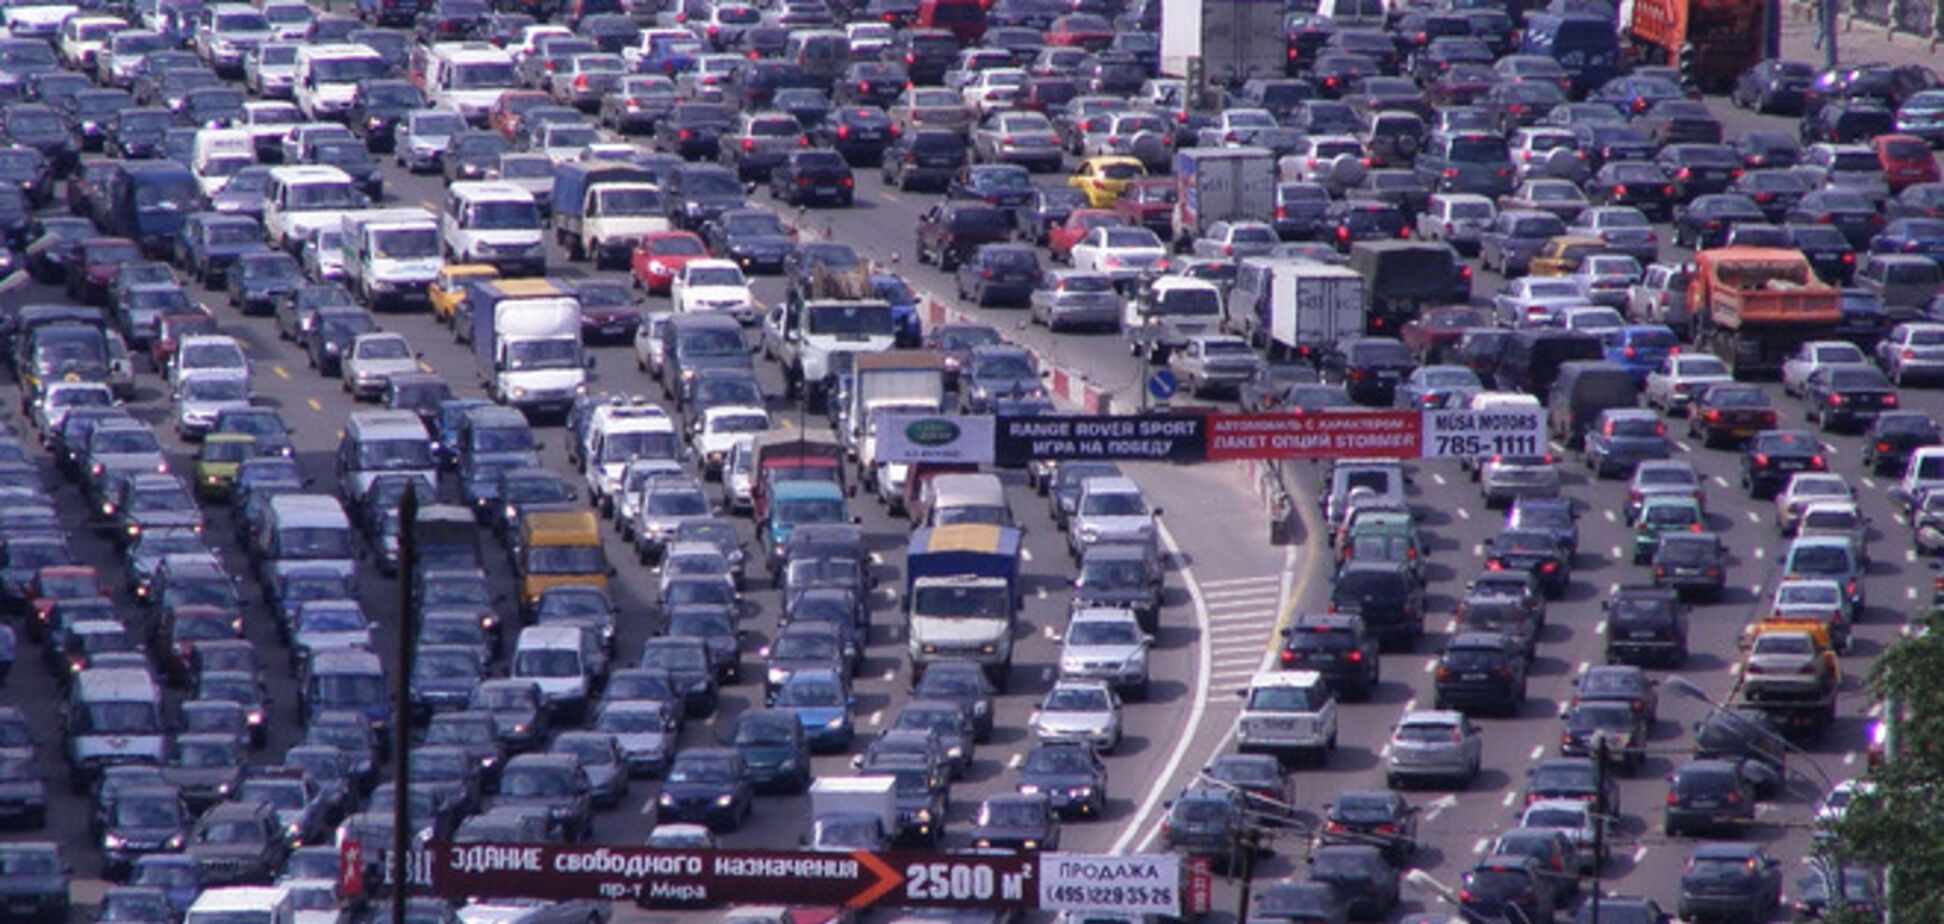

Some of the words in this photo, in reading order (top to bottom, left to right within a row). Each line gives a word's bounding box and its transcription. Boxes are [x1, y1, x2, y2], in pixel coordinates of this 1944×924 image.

[1010, 422, 1068, 437] RANGE
[1076, 422, 1134, 437] ROVER
[1140, 421, 1197, 436] SPORT
[1436, 415, 1476, 431] MUSA
[1479, 415, 1538, 431] MOTORS
[1033, 440, 1076, 454] ИГРА
[1080, 440, 1104, 454] НА
[1109, 440, 1173, 456] ПОБЕДУ
[1214, 433, 1266, 449] ПАКЕТ
[1271, 432, 1331, 449] ОПЦИЙ
[1335, 432, 1415, 448] STORMER
[1436, 435, 1537, 455] 785-1111
[450, 847, 543, 872] ЗДАНИЕ
[555, 848, 702, 876] свободного
[715, 858, 859, 879] назначения
[1059, 863, 1160, 881] ПРОДАЖА
[906, 863, 994, 900] 2500
[600, 882, 642, 898] пр-т
[650, 882, 706, 899] Мира
